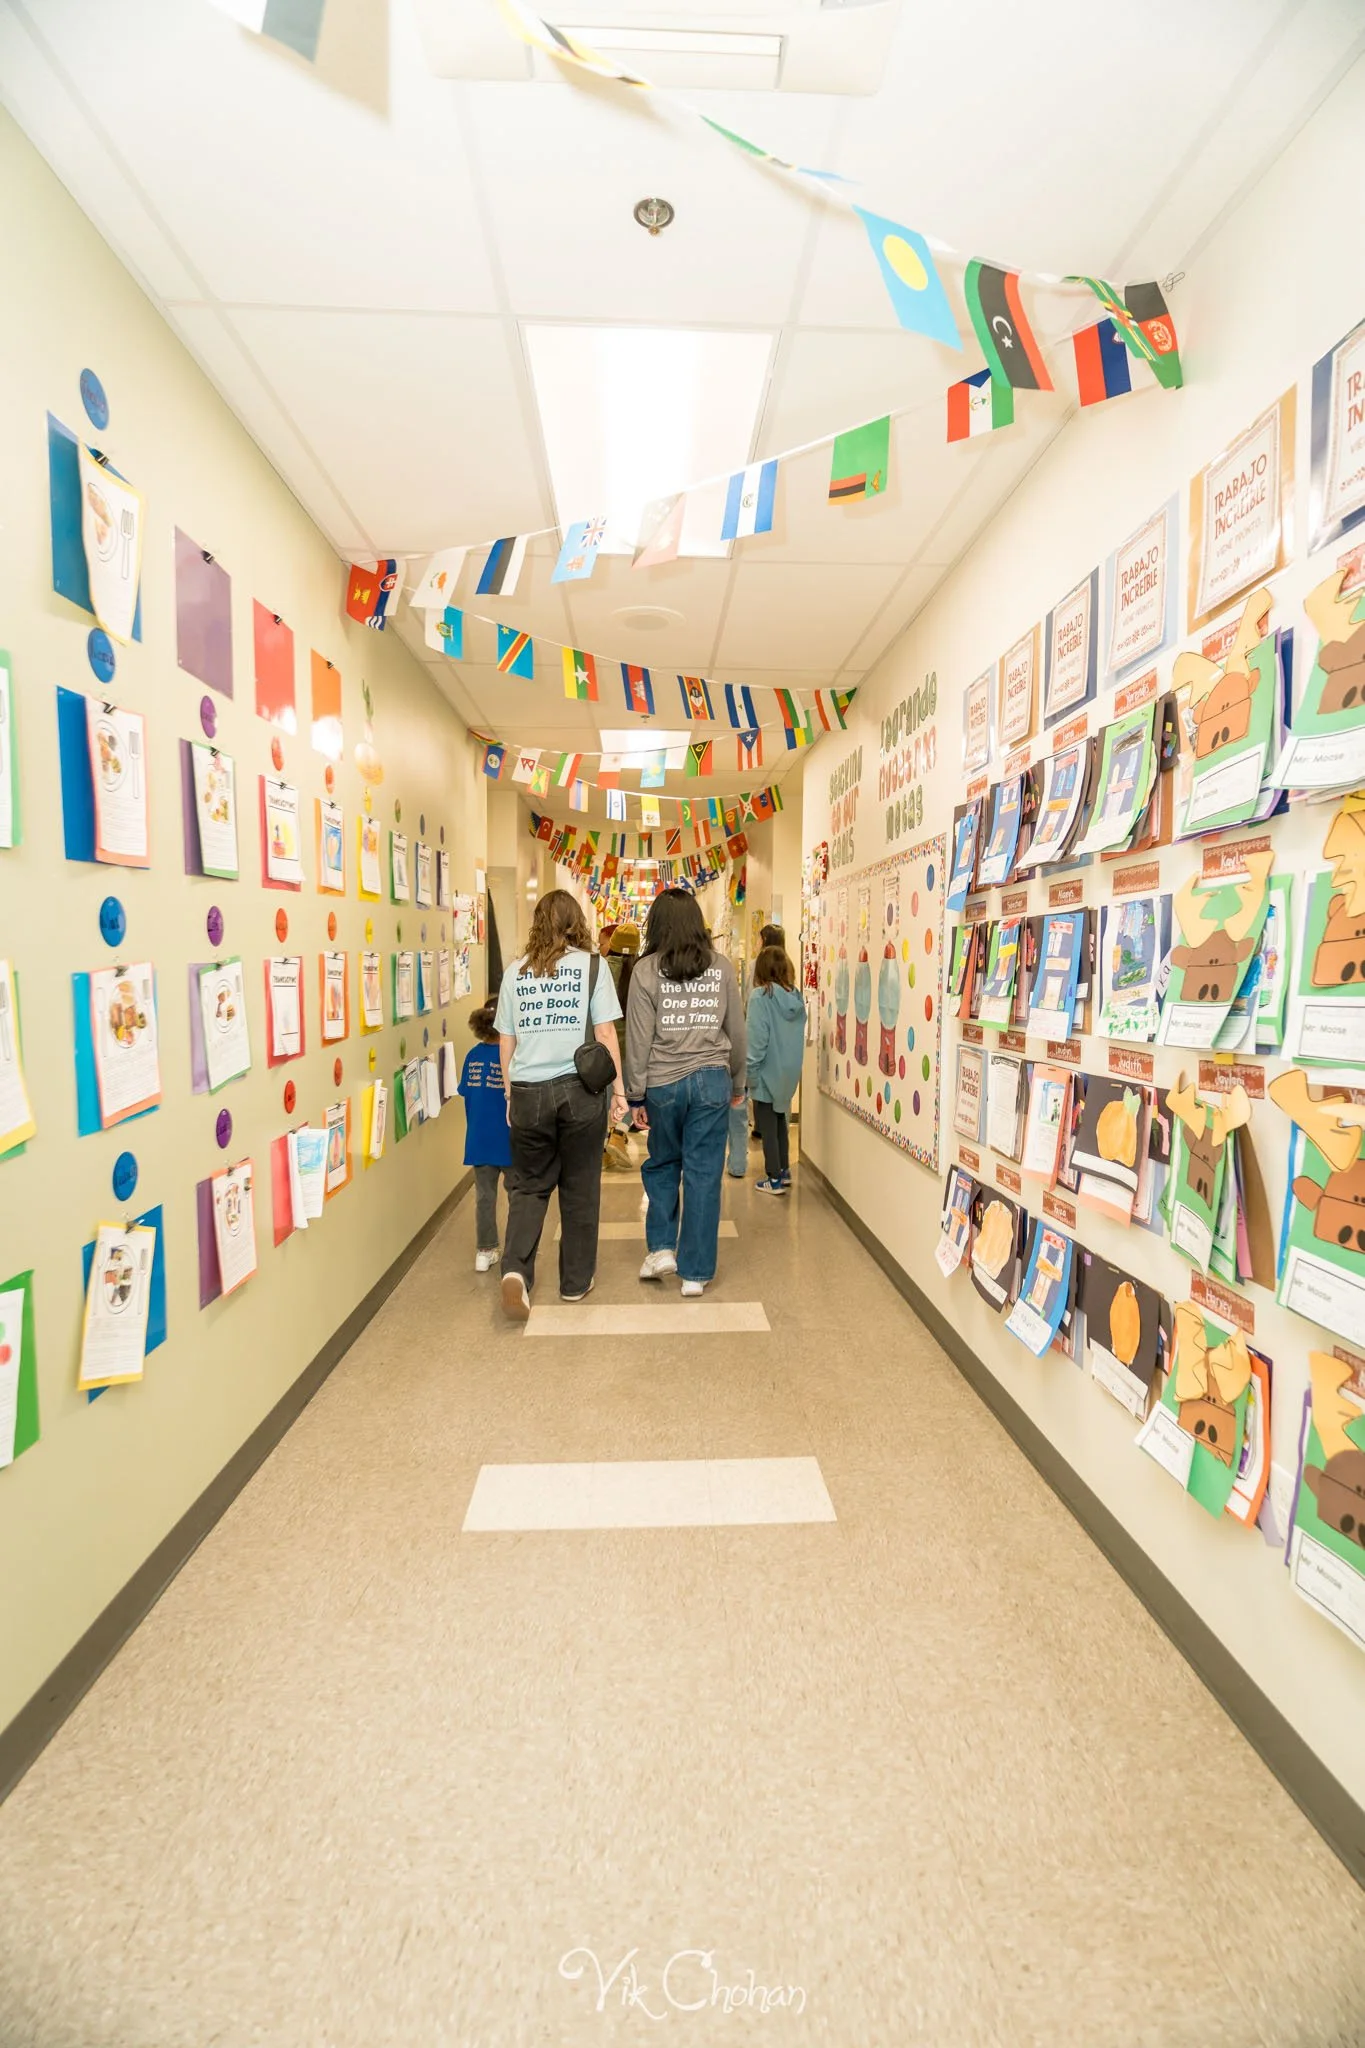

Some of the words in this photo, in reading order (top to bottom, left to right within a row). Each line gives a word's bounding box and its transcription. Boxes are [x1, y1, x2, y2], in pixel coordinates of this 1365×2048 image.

[1215, 454, 1267, 515] TRABAJO
[1121, 545, 1159, 591] TRABAJO
[1057, 612, 1083, 642] TRABAJO
[516, 986, 537, 997] the
[540, 981, 581, 993] World
[661, 982, 682, 993] the
[684, 981, 721, 993] World
[520, 1000, 543, 1012] One
[547, 997, 580, 1009] Book
[662, 998, 687, 1009] One
[690, 997, 719, 1009] Book
[518, 1016, 531, 1028] at
[533, 1017, 542, 1026] a
[545, 1013, 581, 1025] Time.
[661, 1013, 676, 1024] at
[676, 1015, 686, 1024] a
[688, 1012, 719, 1024] Time.
